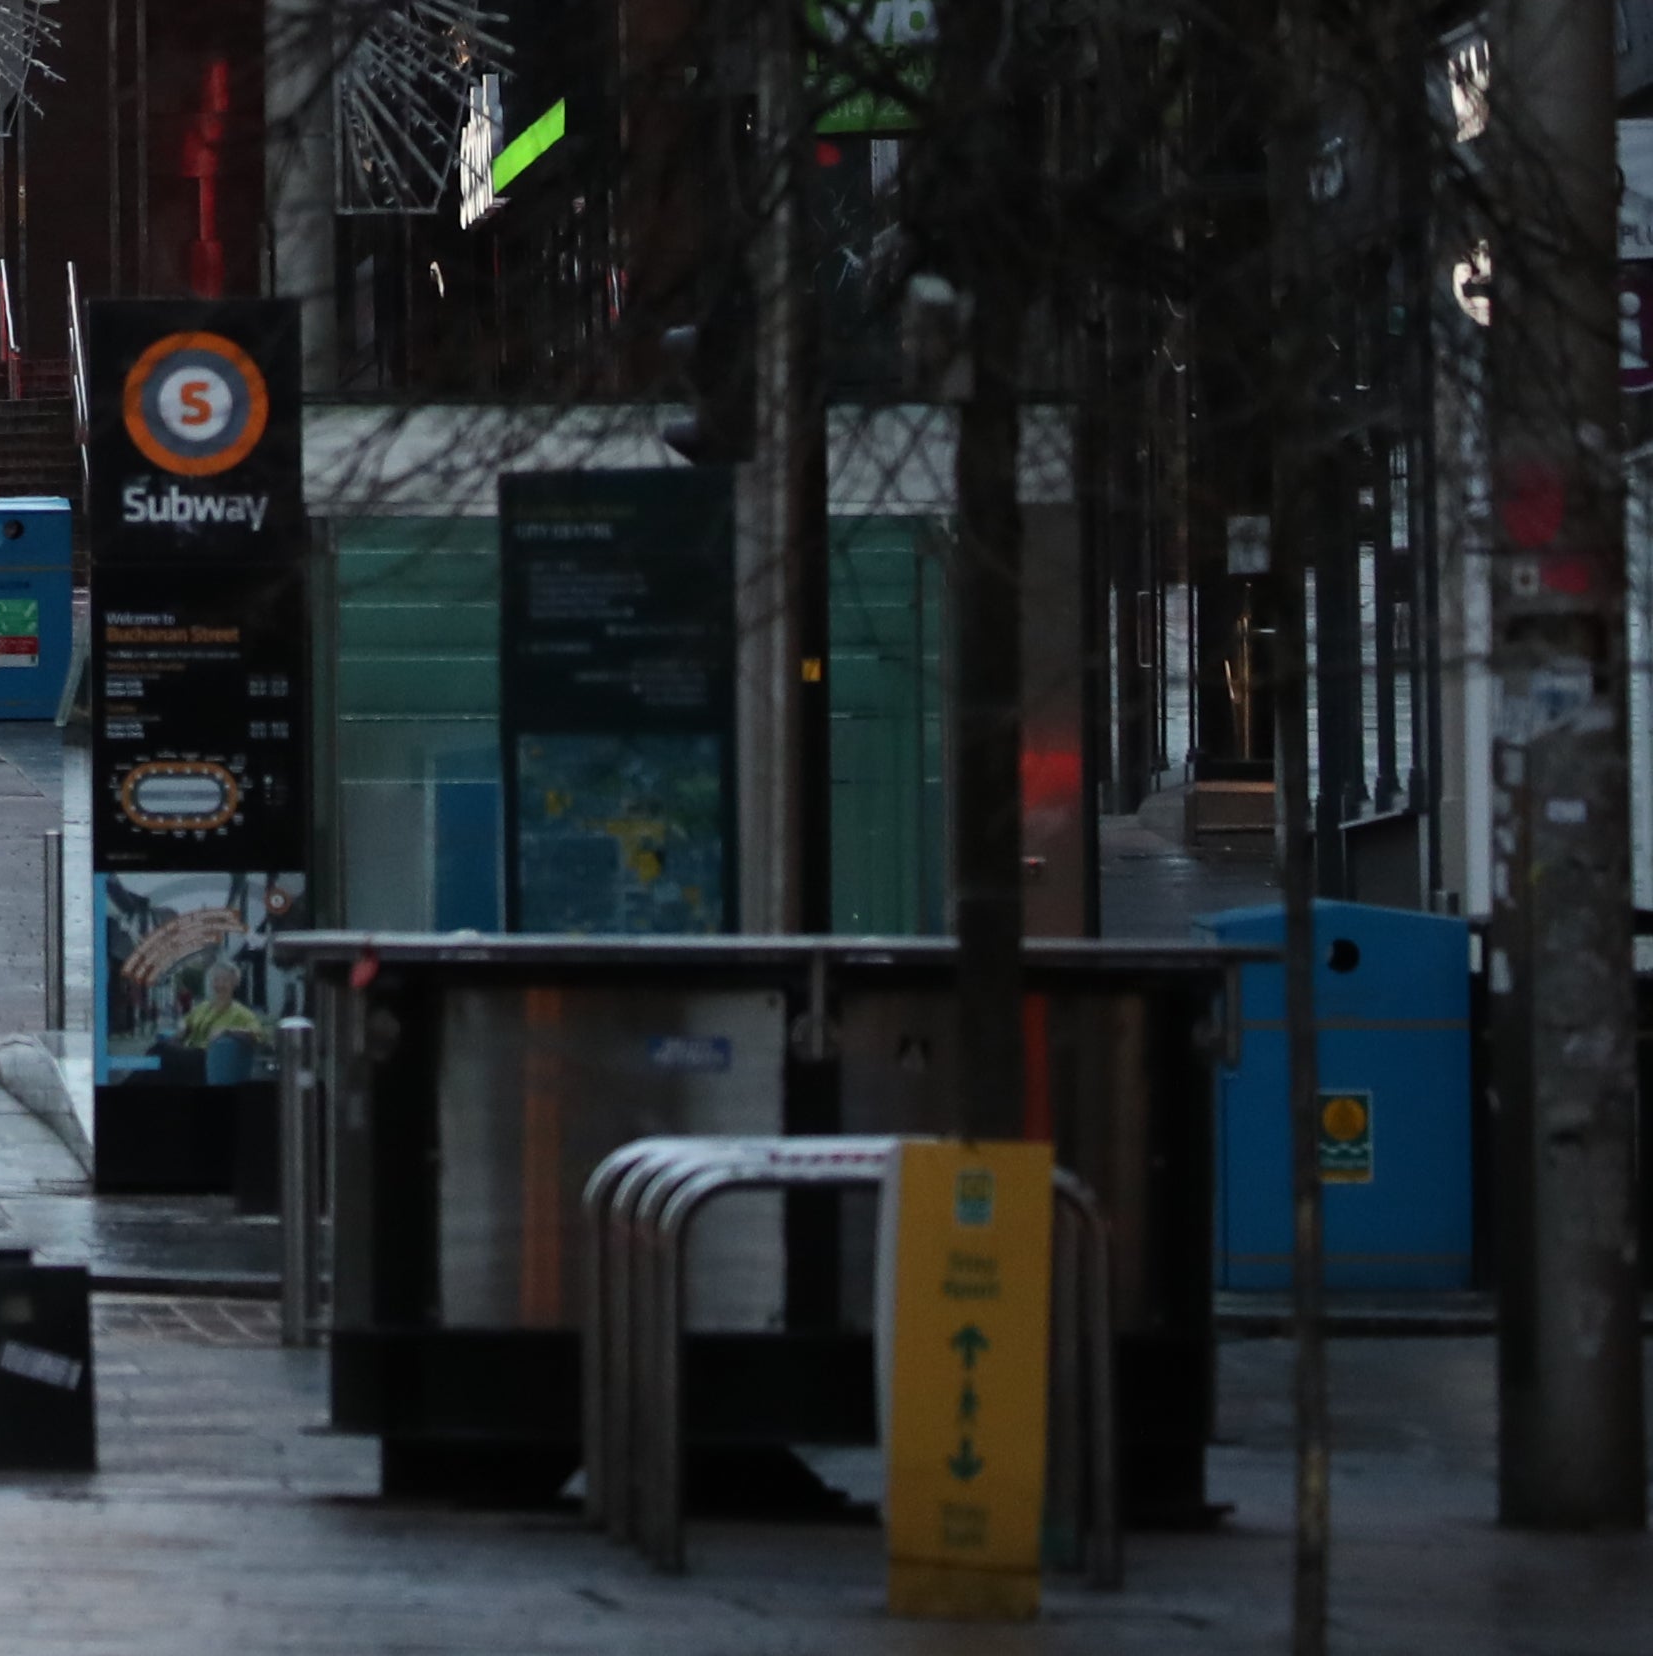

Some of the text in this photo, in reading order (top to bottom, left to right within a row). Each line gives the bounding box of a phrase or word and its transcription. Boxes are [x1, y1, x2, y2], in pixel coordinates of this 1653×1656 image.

[178, 380, 211, 426] S
[123, 487, 269, 532] Subway
[106, 612, 175, 626] Welcome to
[106, 627, 240, 643] Buchanan Street
